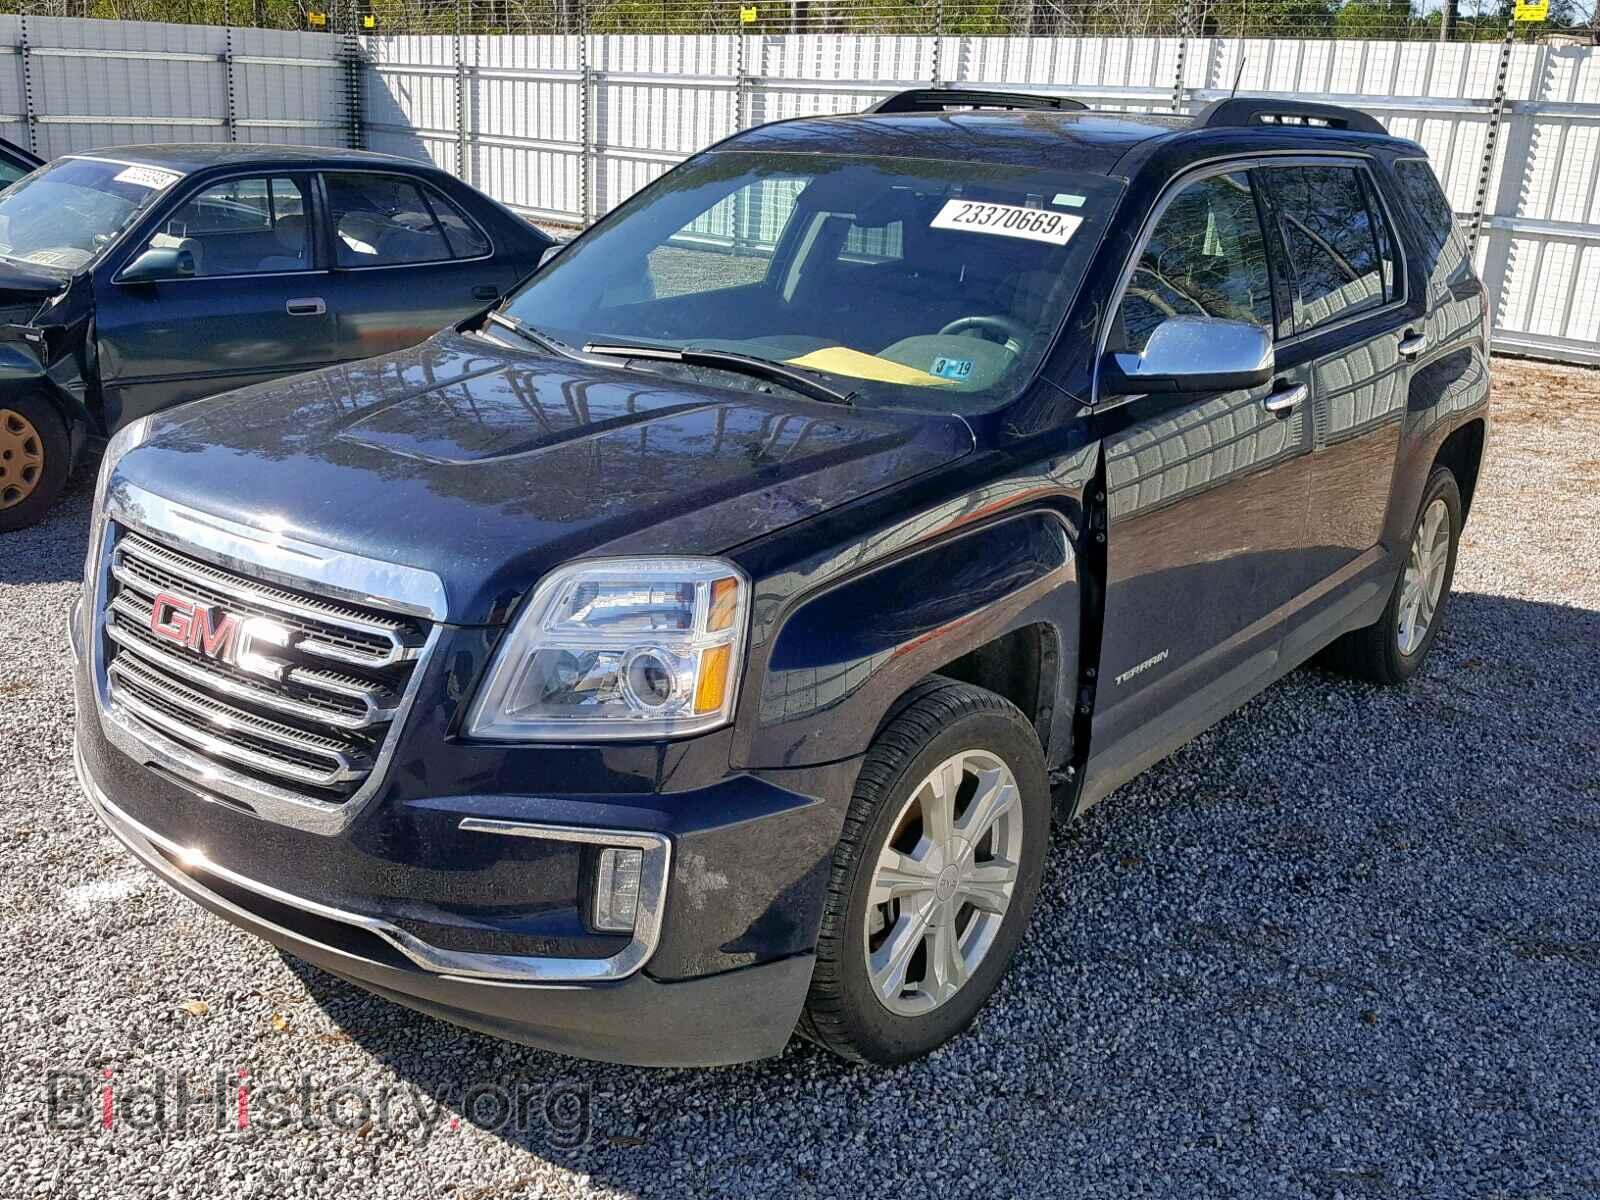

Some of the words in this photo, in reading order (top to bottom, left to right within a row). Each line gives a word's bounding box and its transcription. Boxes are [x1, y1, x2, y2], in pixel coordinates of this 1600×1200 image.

[936, 359, 946, 374] 3
[957, 361, 972, 376] 19
[150, 592, 291, 682] GMC
[1115, 648, 1169, 686] TERRAIN
